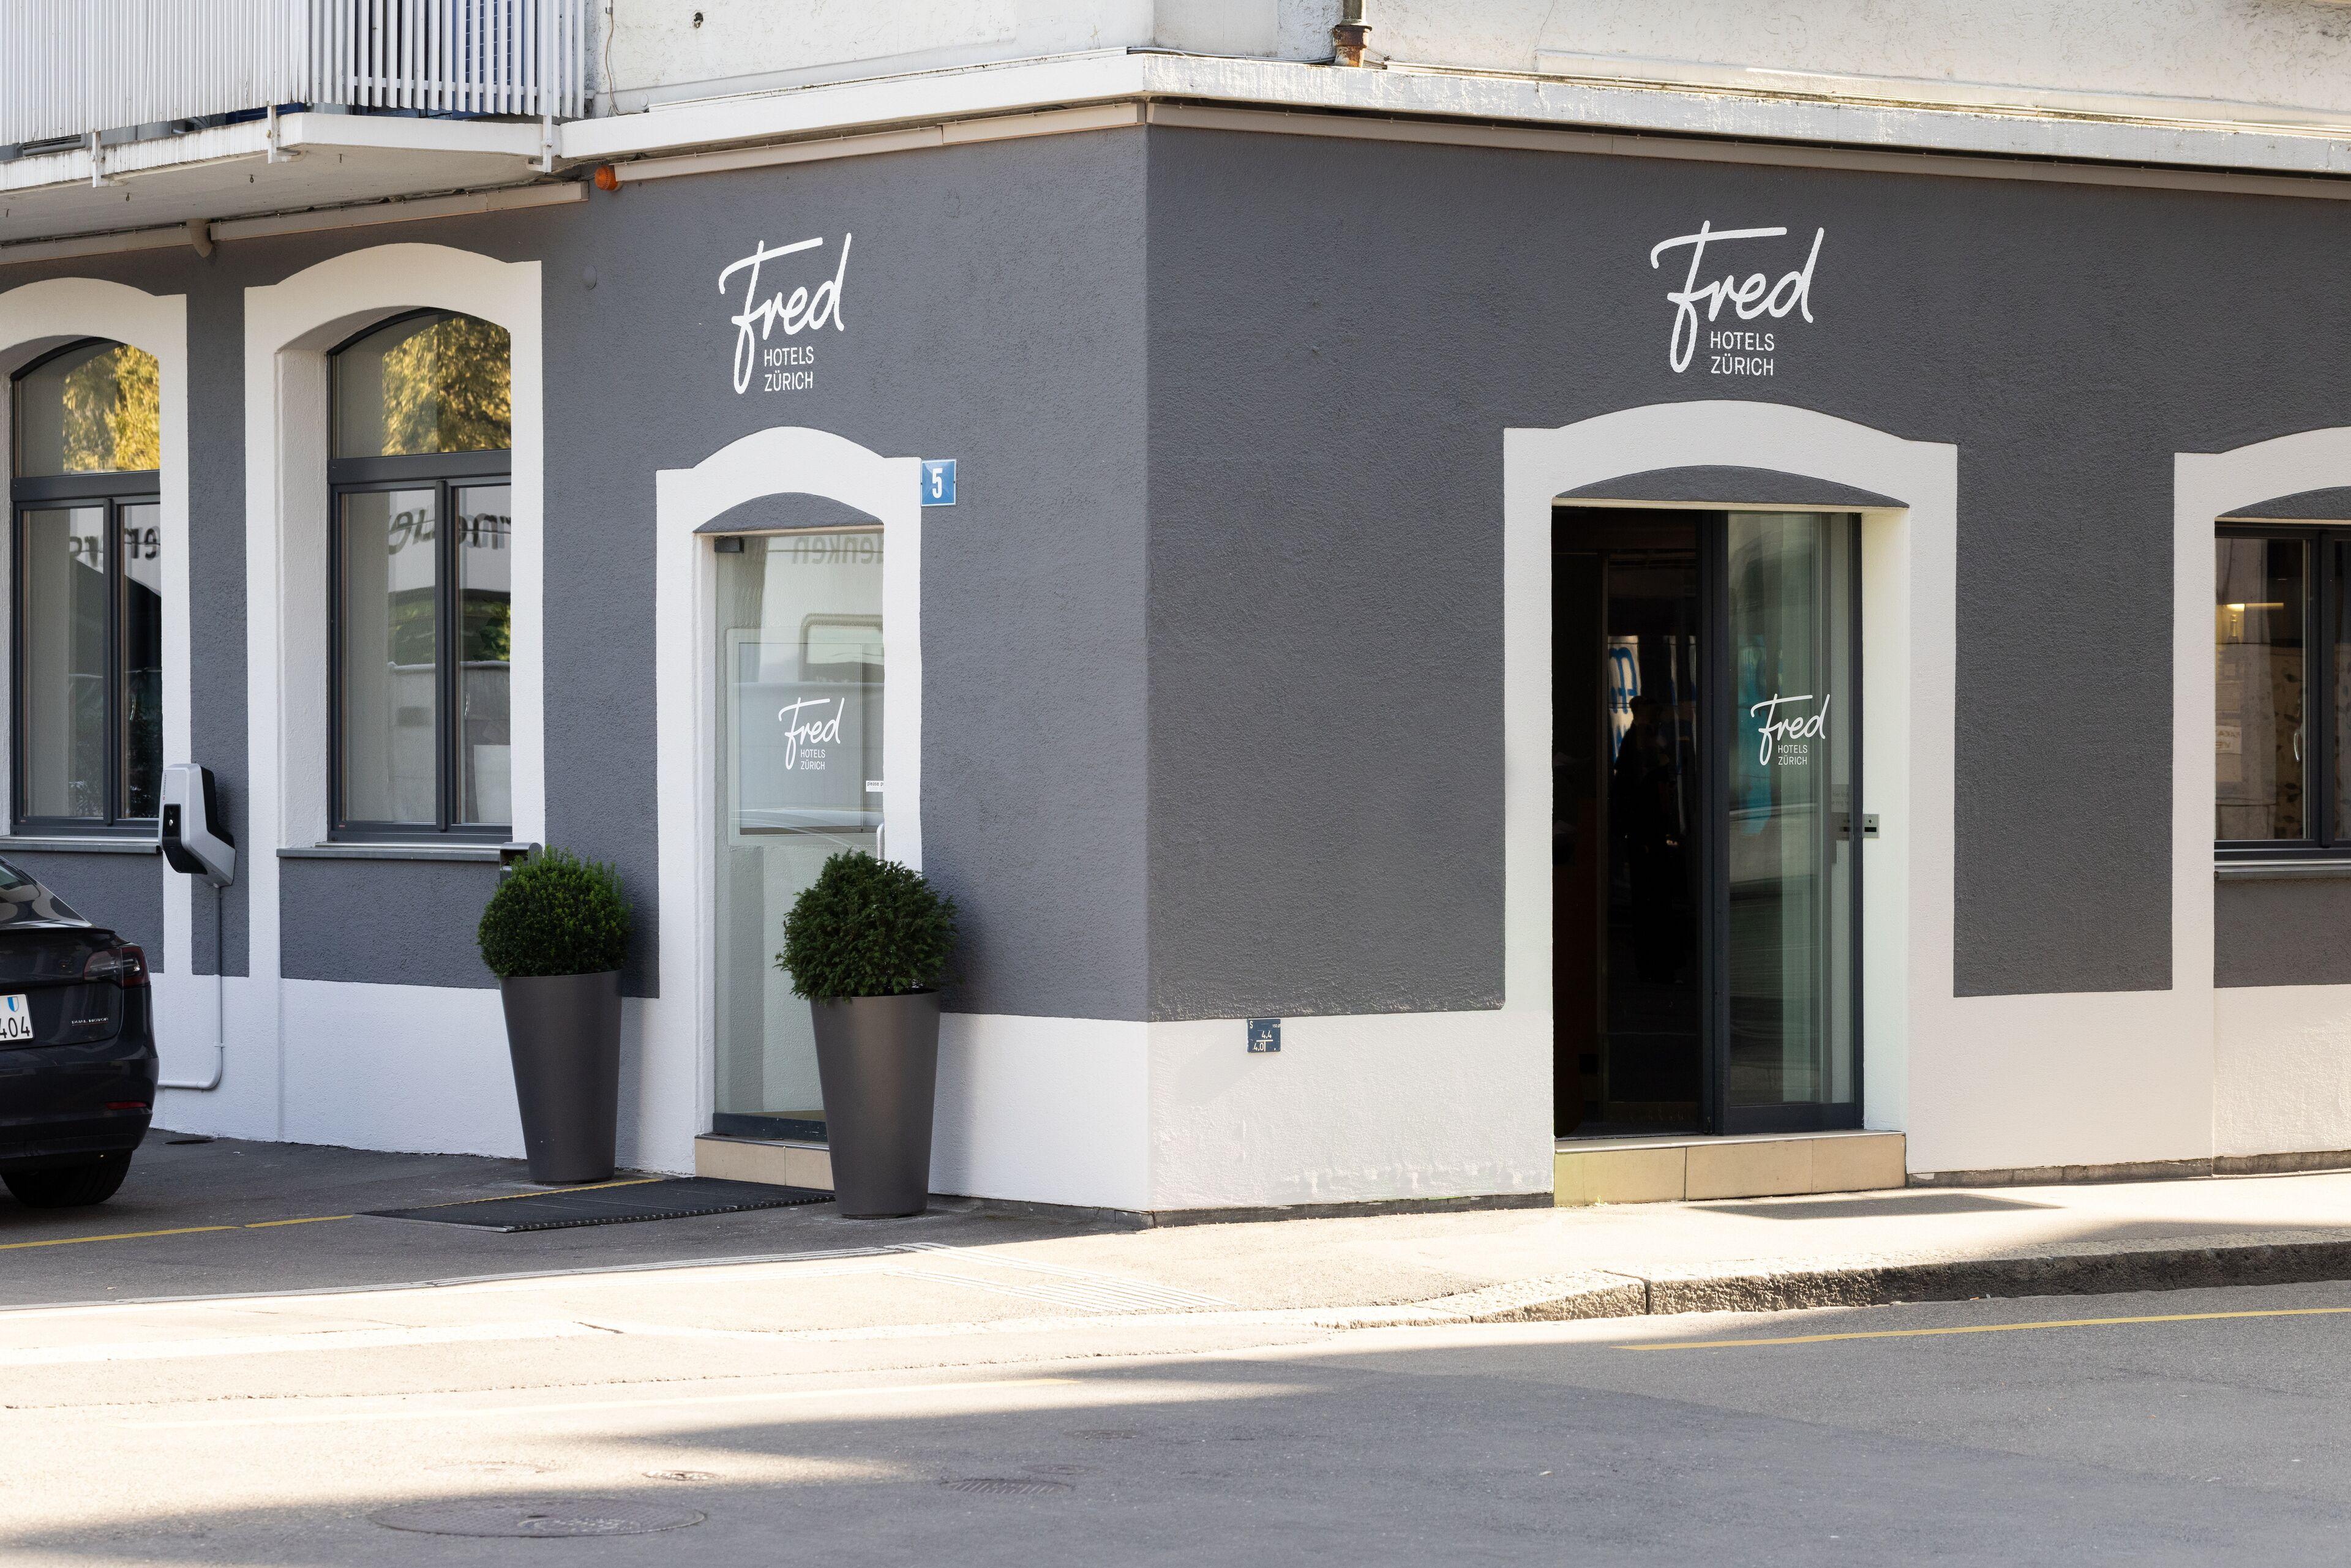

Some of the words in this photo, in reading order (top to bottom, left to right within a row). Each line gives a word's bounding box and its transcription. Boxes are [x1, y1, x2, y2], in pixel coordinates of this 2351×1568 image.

[1651, 220, 1824, 373] Fred
[719, 233, 852, 394] Fred
[1710, 331, 1775, 351] HOTELS
[764, 346, 814, 367] HOTELS
[1711, 353, 1774, 376] ZÜRICH
[765, 370, 813, 392] ZÜRICH
[932, 468, 943, 498] 5
[778, 697, 845, 770] Fred
[1750, 693, 1830, 766] Fred
[800, 749, 826, 759] HOTELS
[1778, 745, 1808, 754] HOTELS
[800, 759, 825, 770] ZÜRICH
[1778, 755, 1807, 765] ZÜRICH
[1250, 1020, 1253, 1029] S
[1262, 1030, 1272, 1039] 4,4
[1253, 1043, 1264, 1051] 4,0
